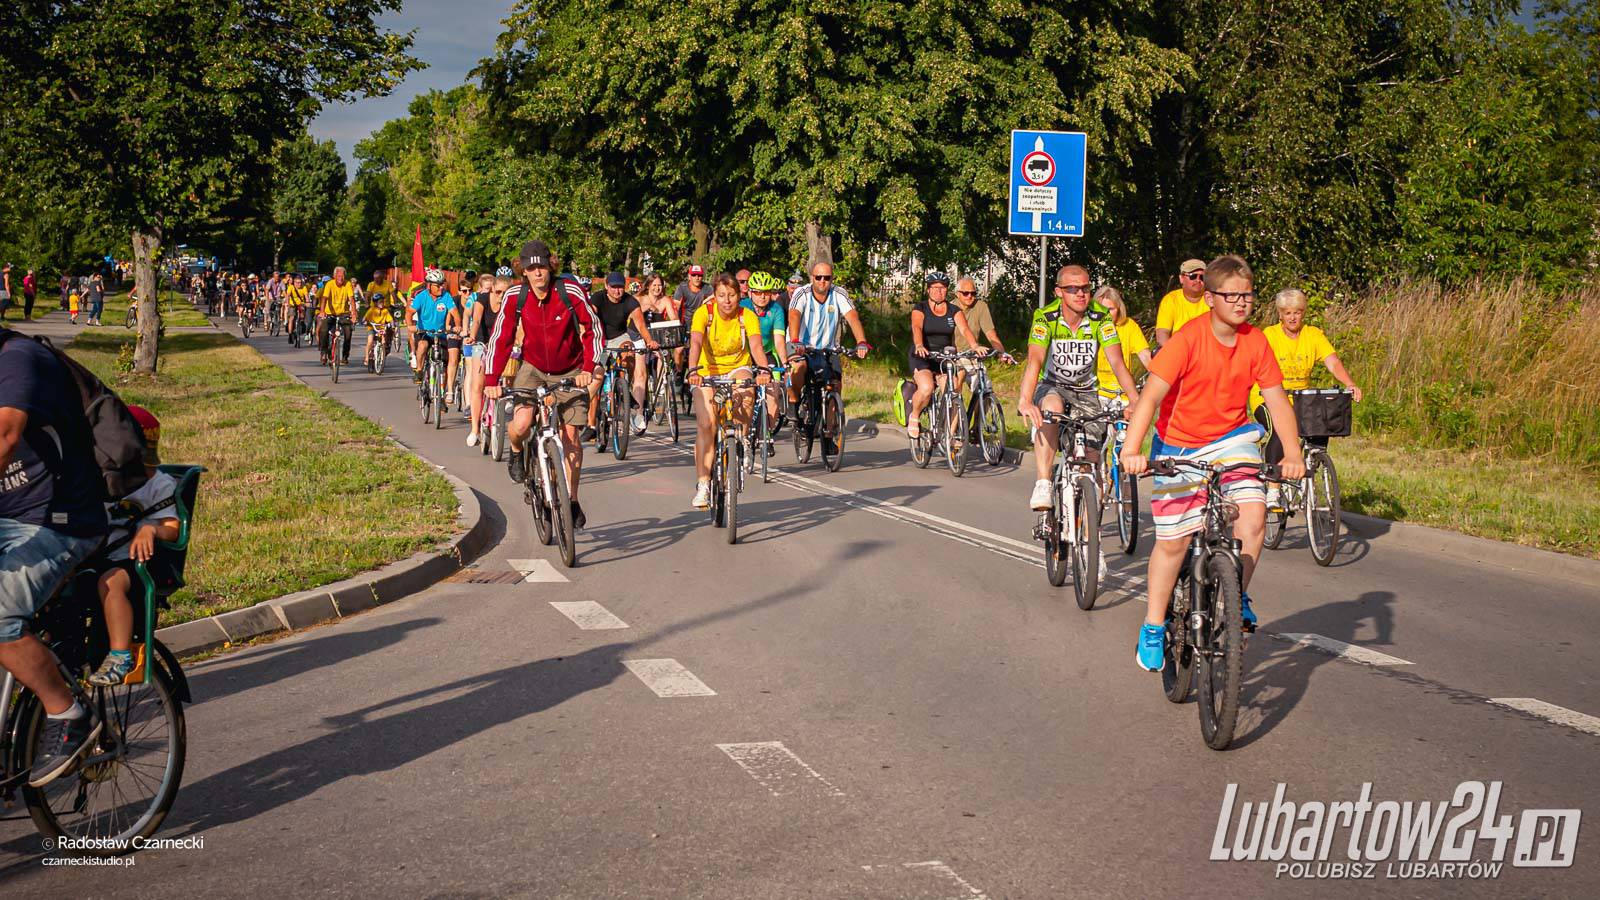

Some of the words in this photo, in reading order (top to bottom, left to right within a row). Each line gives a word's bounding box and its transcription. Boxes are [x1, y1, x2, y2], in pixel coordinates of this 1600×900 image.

[1047, 219, 1063, 231] 1,4
[1064, 223, 1076, 231] km
[1056, 341, 1094, 354] SUPER
[5, 459, 24, 475] AGE
